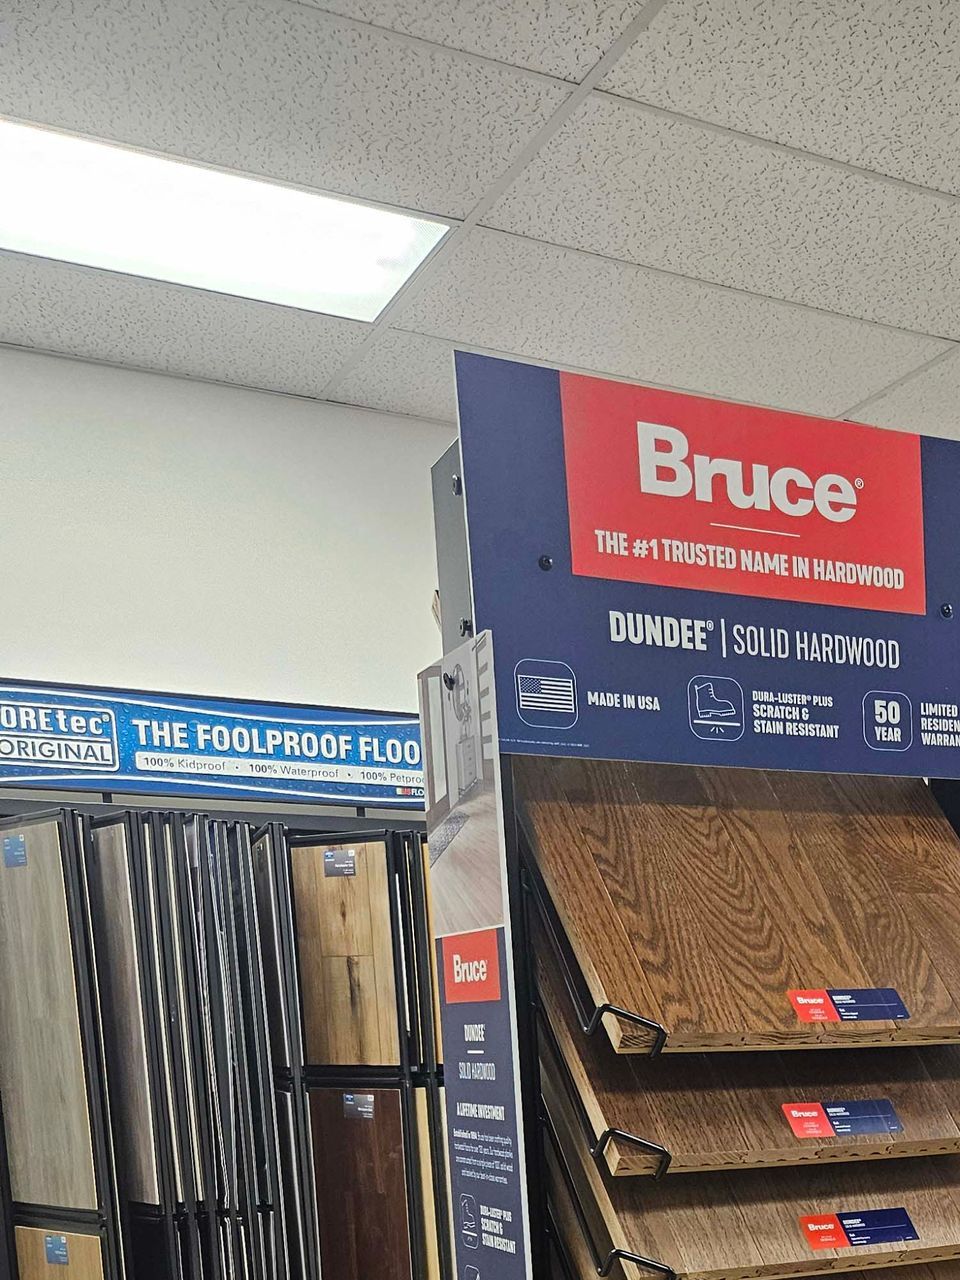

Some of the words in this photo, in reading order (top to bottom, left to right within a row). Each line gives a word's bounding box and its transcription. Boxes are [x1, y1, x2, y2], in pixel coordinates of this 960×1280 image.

[595, 529, 628, 557] THE
[632, 537, 659, 561] #1
[661, 538, 736, 571] TRUSTED
[741, 553, 788, 578] NAME
[792, 556, 809, 579] IN
[813, 560, 905, 590] HARDWOOD
[733, 625, 789, 660] SOLID
[796, 630, 900, 670] HARDWOOD
[587, 691, 620, 708] MADE
[623, 694, 635, 709] IN
[637, 695, 660, 711] USA
[812, 695, 833, 707] PLUS
[920, 703, 958, 718] LIMITED
[752, 704, 800, 720] SCRATCH
[801, 707, 809, 720] &
[874, 700, 901, 724] 50
[753, 720, 784, 736] STAIN
[786, 722, 839, 739] RESISTANT
[875, 726, 901, 742] YEAR
[132, 718, 189, 749] THE
[197, 723, 352, 761] FOOLPROOF
[0, 739, 110, 762] ORIGINAL
[144, 756, 175, 769] 100%
[177, 757, 226, 772] Kidproof
[249, 763, 278, 775] 100%
[280, 764, 339, 779] Waterproof
[361, 771, 387, 781] 100%
[453, 954, 488, 983] Bruce
[796, 996, 824, 1004] Bruce
[459, 1062, 471, 1079] SOLID
[472, 1062, 496, 1080] HARDWOOD
[791, 1109, 818, 1118] Bruce
[808, 1223, 834, 1231] Bruce
